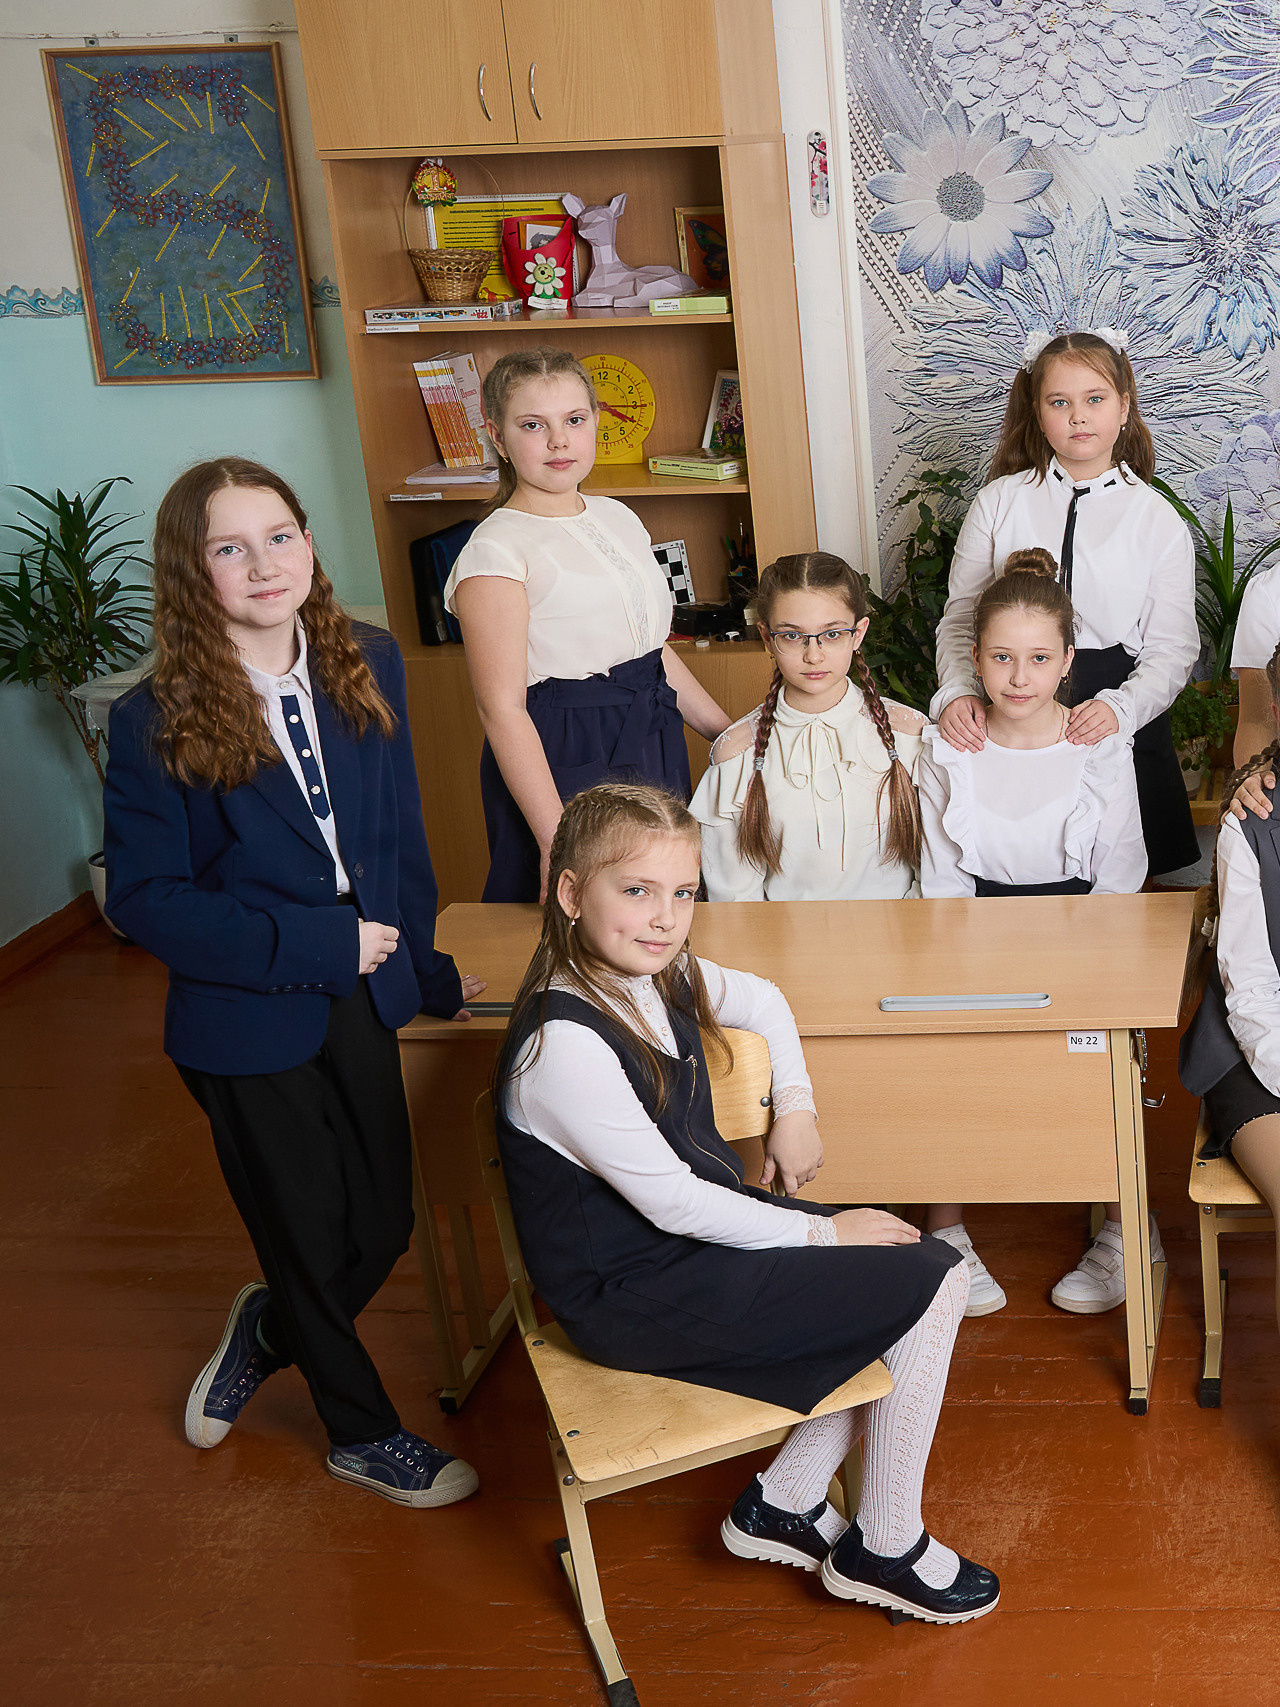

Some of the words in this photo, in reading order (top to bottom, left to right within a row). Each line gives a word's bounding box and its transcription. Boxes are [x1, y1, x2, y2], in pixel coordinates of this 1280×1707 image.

[598, 371, 608, 380] 12
[616, 374, 621, 383] 1
[628, 386, 634, 394] 2
[631, 400, 638, 409] 3
[619, 427, 626, 435] 5
[603, 432, 609, 441] 6
[1070, 1036, 1083, 1045] №
[1085, 1036, 1098, 1045] 22
